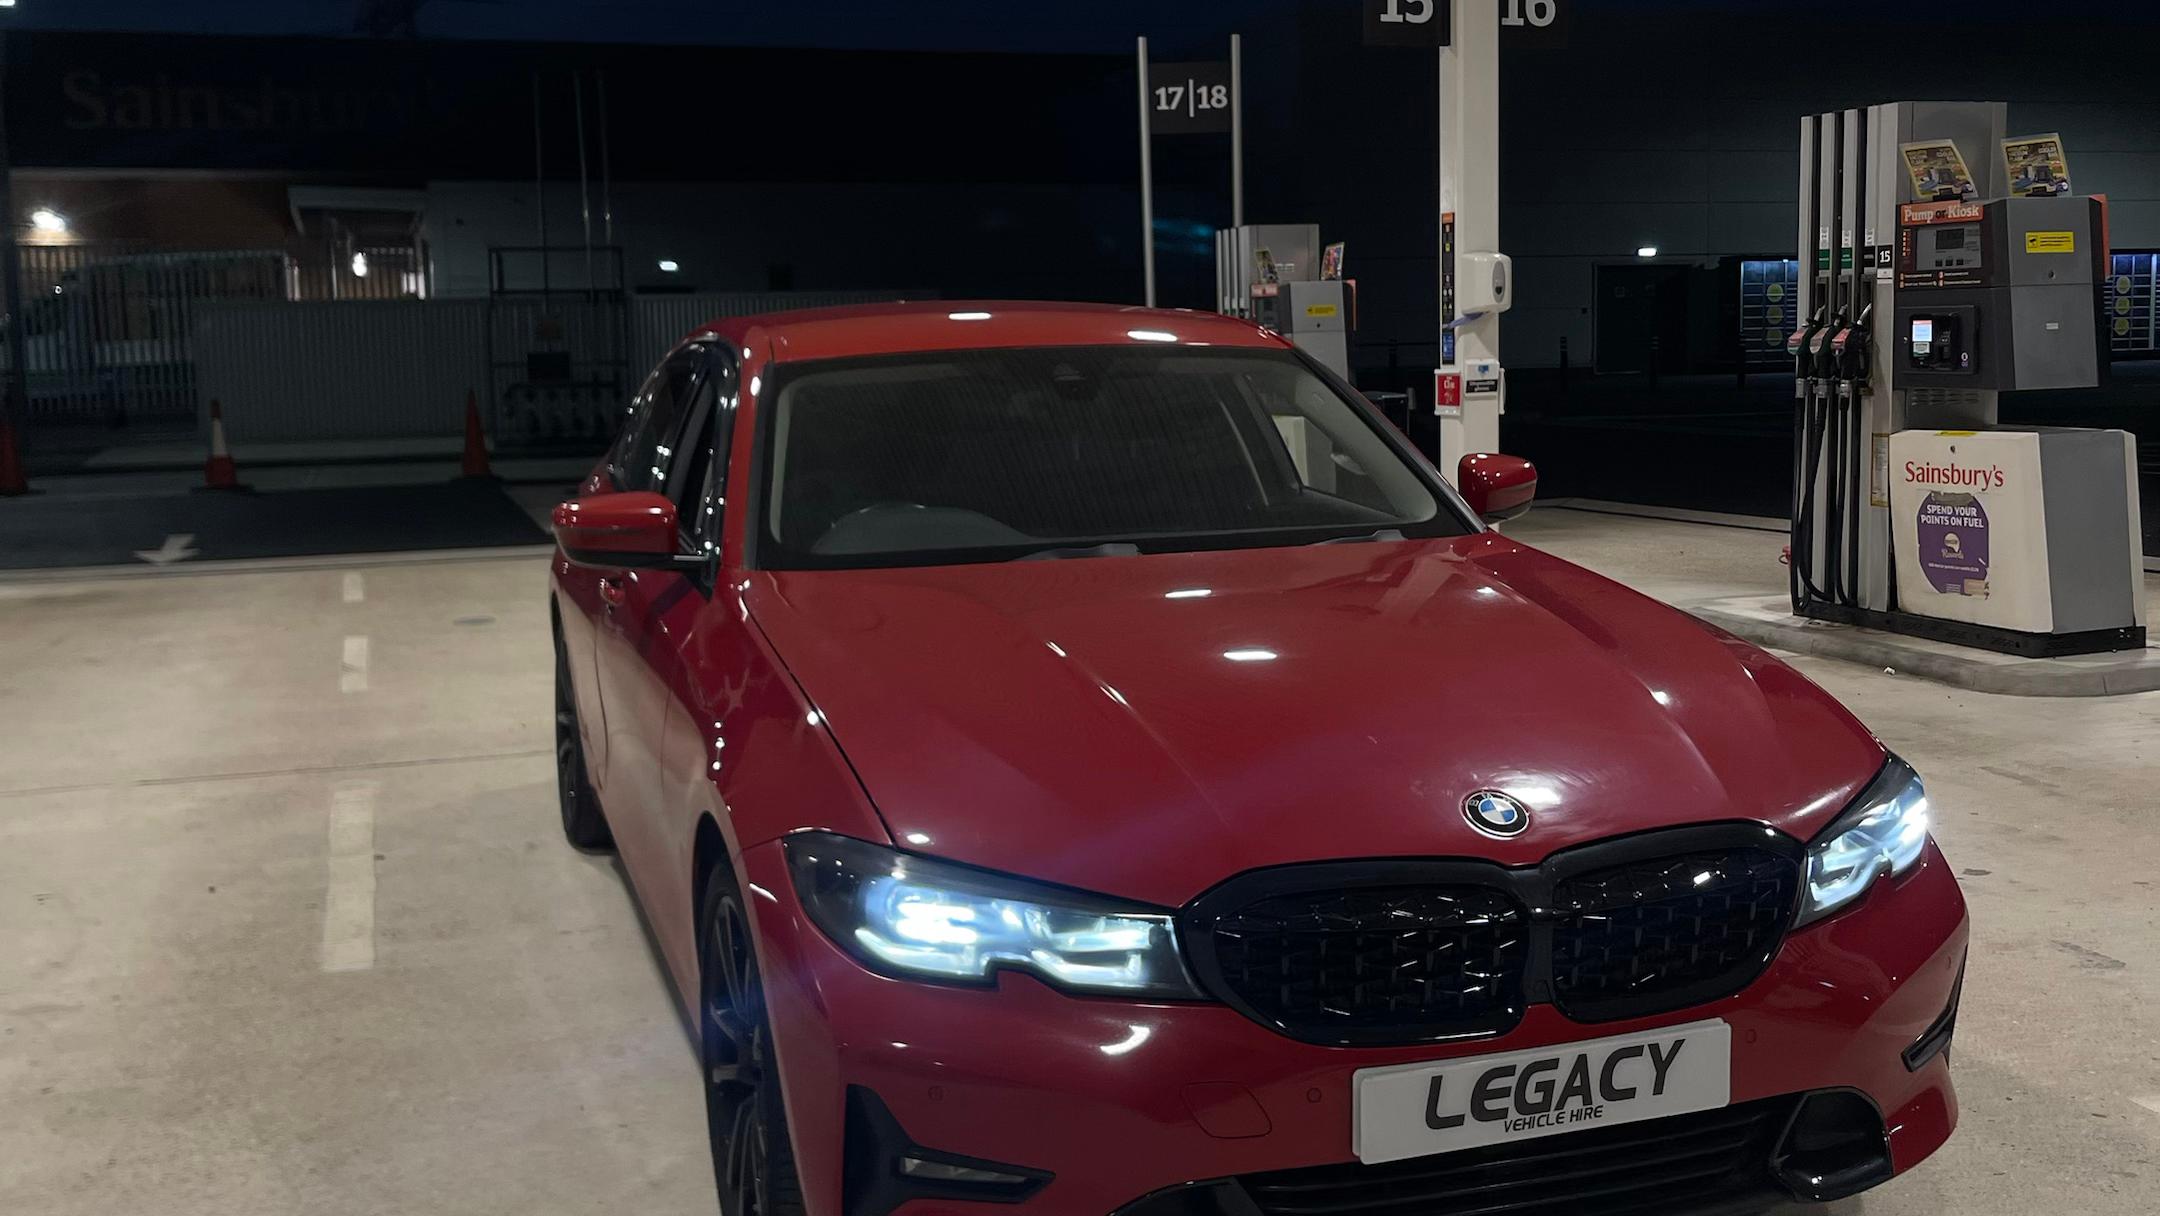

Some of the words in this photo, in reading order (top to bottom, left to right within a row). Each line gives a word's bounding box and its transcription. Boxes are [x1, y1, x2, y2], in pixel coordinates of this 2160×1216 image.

[1379, 0, 1434, 24] 15
[1501, 0, 1556, 28] 16
[61, 68, 436, 132] Sainsbur
[1155, 86, 1184, 111] 17
[1197, 85, 1228, 109] 18
[1904, 208, 1934, 224] Pump
[1935, 210, 1946, 219] or
[1947, 205, 1979, 219] Kiosk
[1879, 250, 1891, 263] 15
[1905, 461, 2004, 491] Sainsbury's
[1920, 515, 1949, 526] POINTS
[1950, 517, 1963, 527] ON
[1963, 518, 1985, 528] FUEL
[1927, 504, 1953, 516] SPEND
[1955, 506, 1977, 517] YOUR
[1425, 1038, 1686, 1131] LEGACY
[1503, 1109, 1566, 1133] VEHICLE
[1569, 1105, 1604, 1124] HIRE
